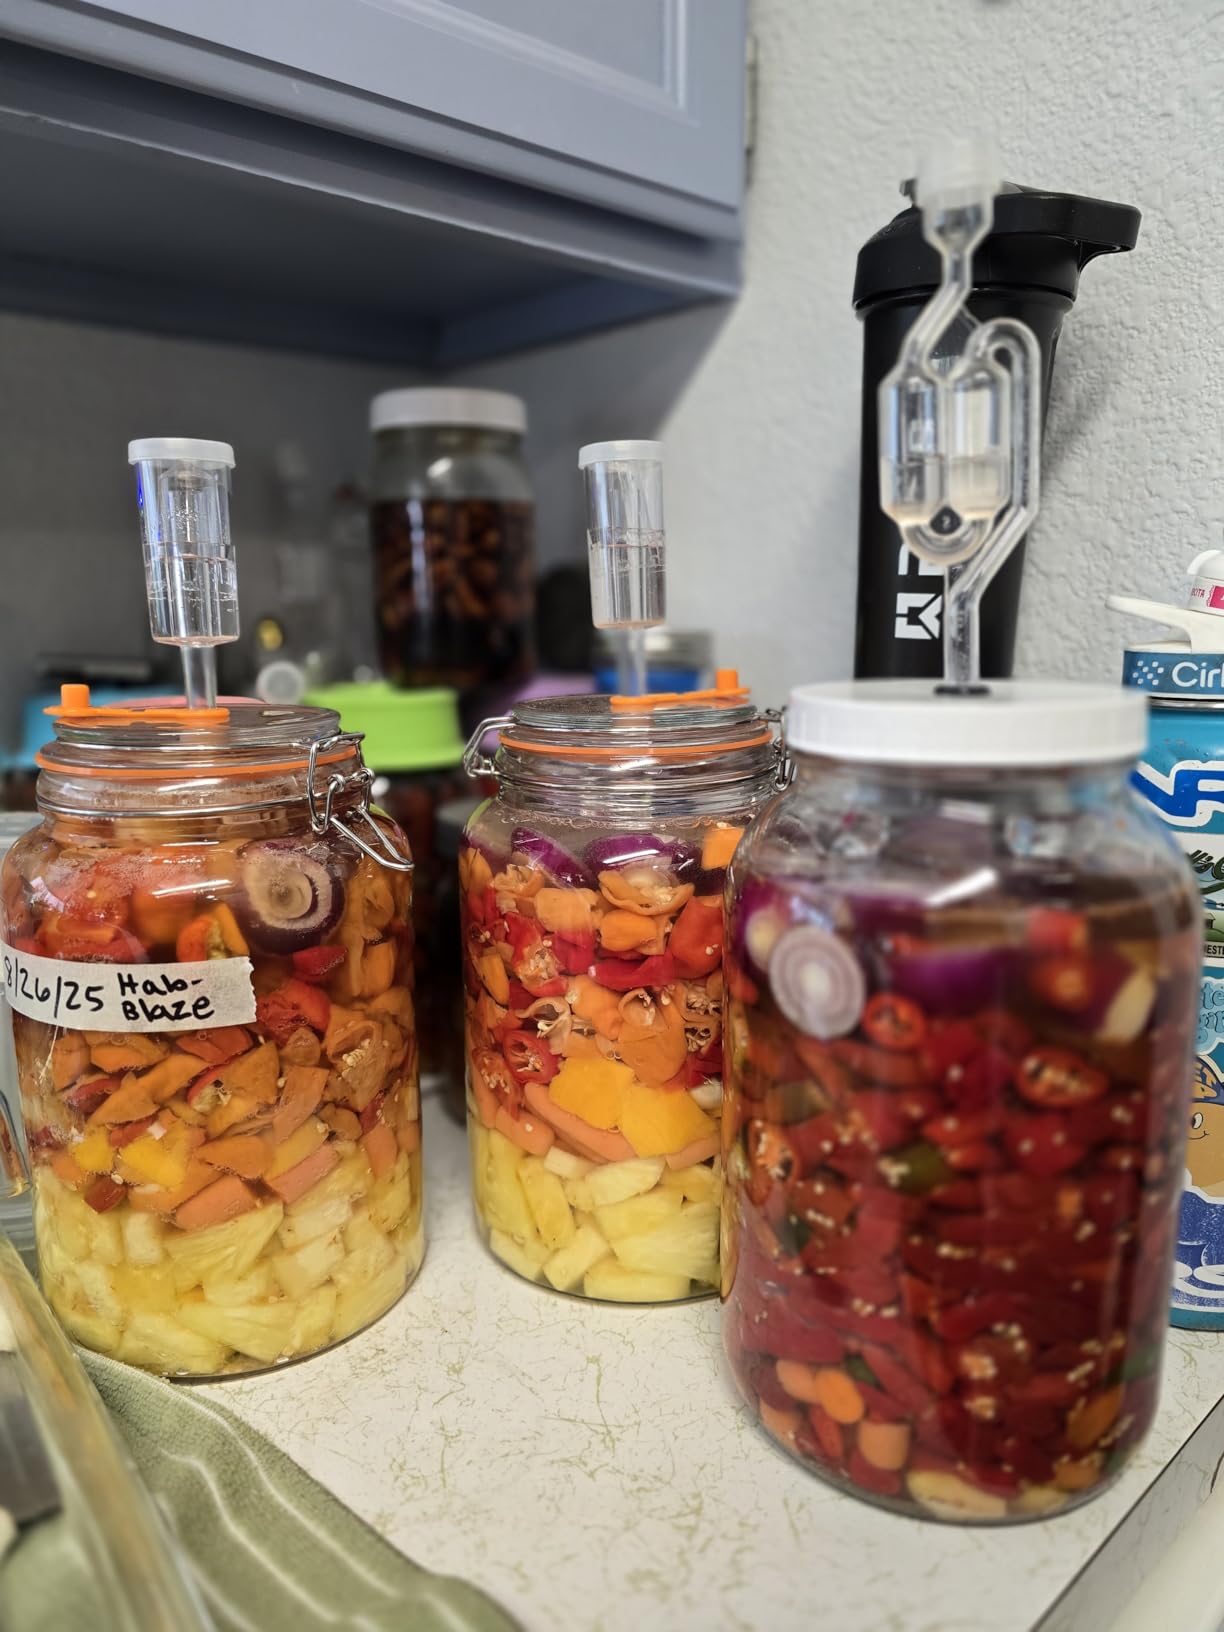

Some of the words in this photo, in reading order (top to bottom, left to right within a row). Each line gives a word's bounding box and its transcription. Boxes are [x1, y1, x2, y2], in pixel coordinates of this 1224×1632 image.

[1172, 661, 1224, 688] Cir
[4, 955, 105, 1018] 8/26/25
[117, 972, 204, 997] Hab-
[121, 996, 215, 1023] Blaze
